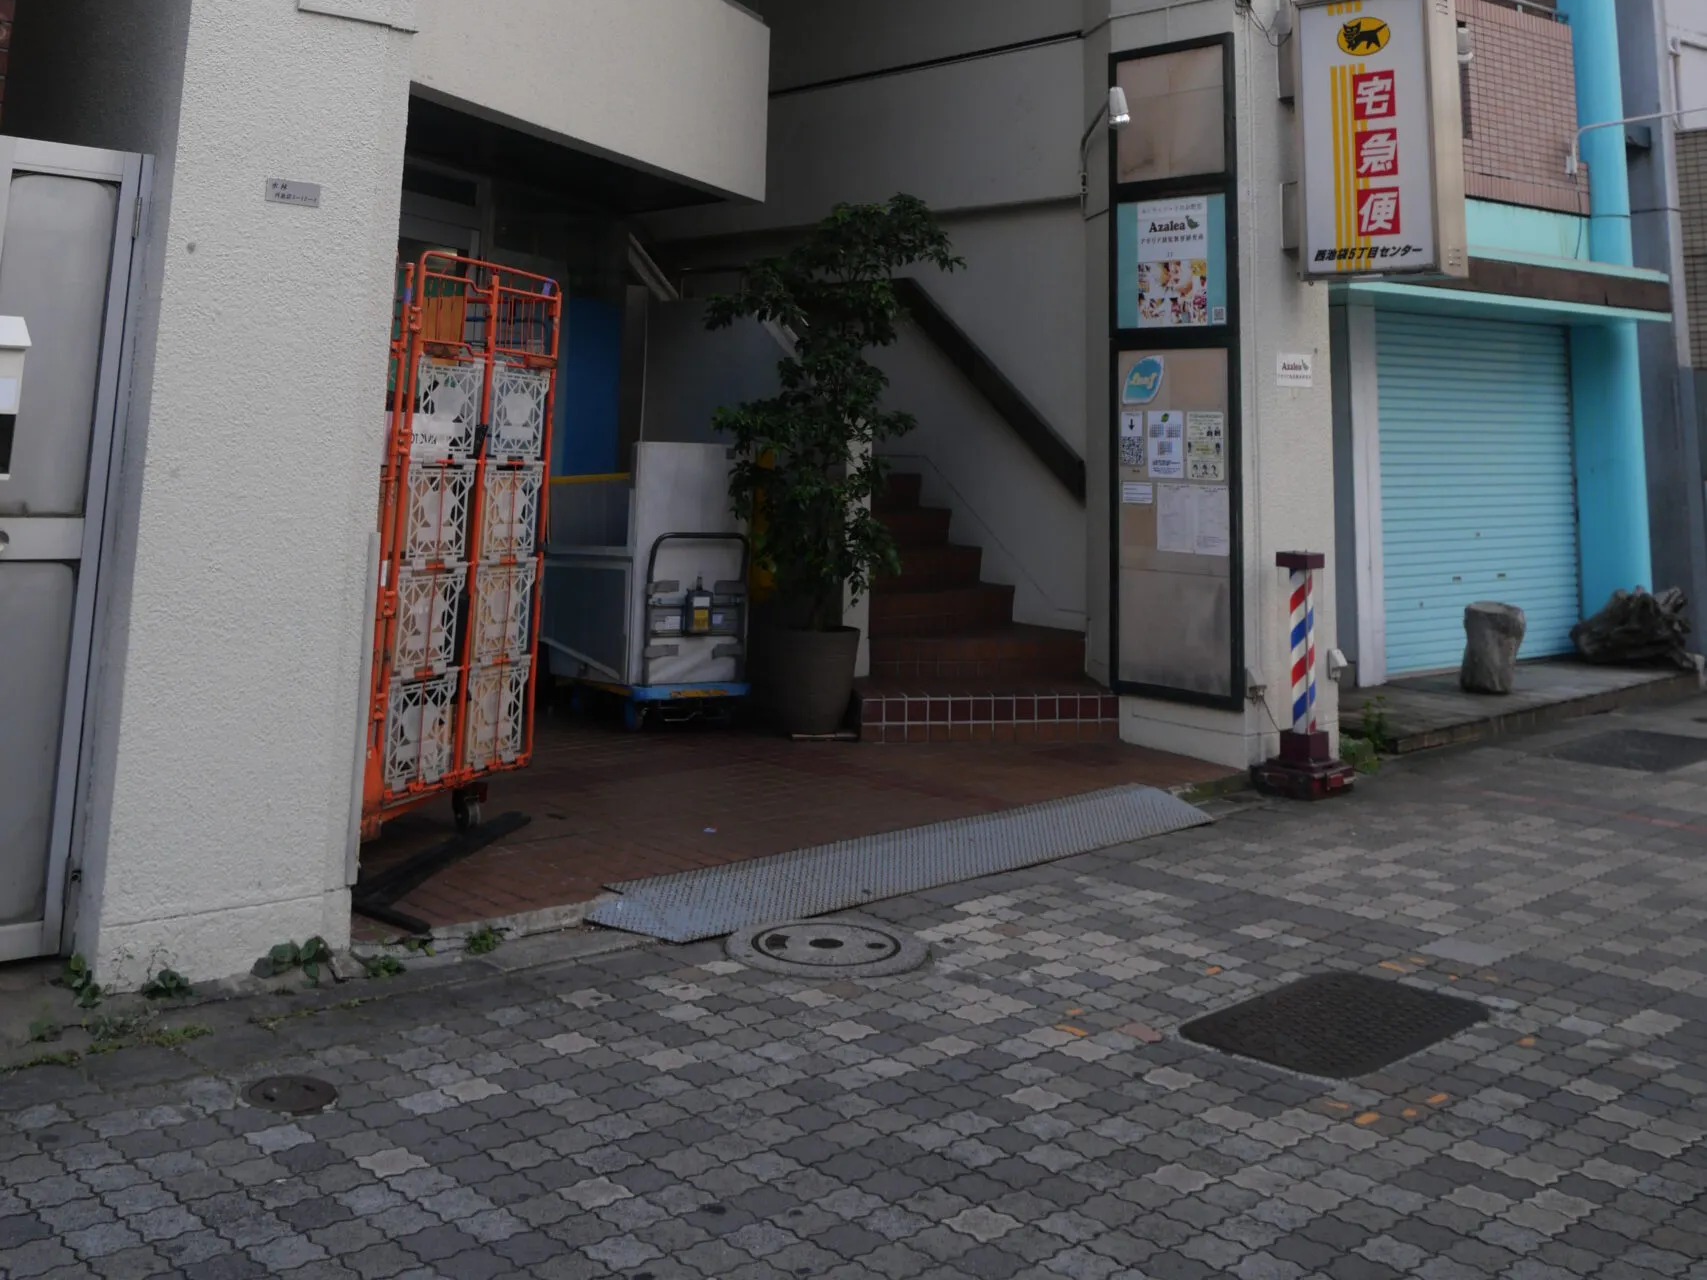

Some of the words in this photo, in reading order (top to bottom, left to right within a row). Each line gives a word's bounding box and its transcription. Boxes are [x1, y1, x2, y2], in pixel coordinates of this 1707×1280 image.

[1354, 75, 1400, 234] 宅急便
[1149, 219, 1186, 233] Azalea
[1314, 244, 1423, 262] 西池袋5丁目センター
